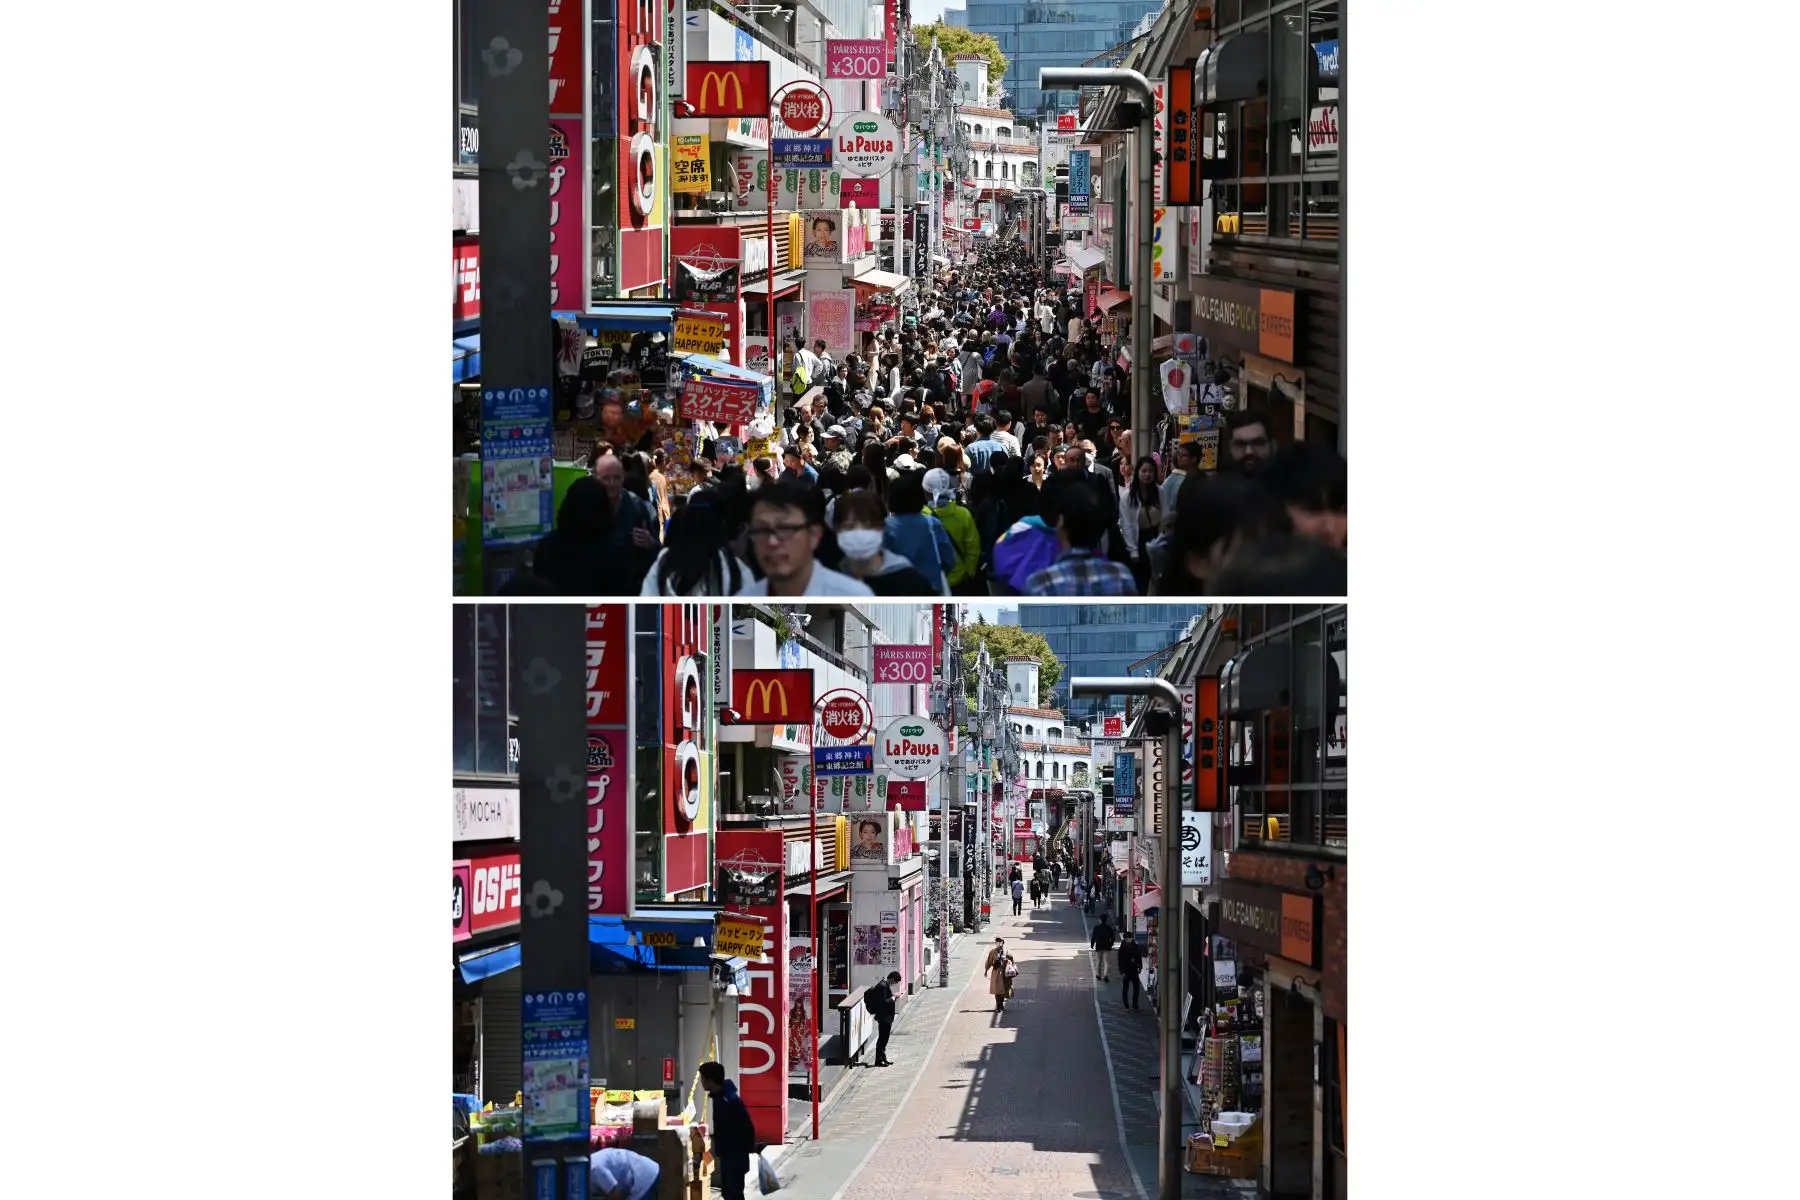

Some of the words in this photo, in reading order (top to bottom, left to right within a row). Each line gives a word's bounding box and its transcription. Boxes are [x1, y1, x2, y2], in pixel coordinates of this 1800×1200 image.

[833, 45, 858, 54] PARIS
[832, 56, 881, 76] ¥300
[783, 101, 820, 119] 消火栓
[784, 143, 821, 153] 東郷神社
[839, 135, 854, 154] La
[855, 135, 894, 155] Pausa
[675, 159, 705, 175] 空席
[1163, 270, 1174, 279] B1
[695, 280, 722, 290] TRAP
[1194, 294, 1235, 327] WOLFGANG
[1235, 302, 1257, 333] PUCK
[1261, 311, 1292, 339] EXPRESS
[677, 323, 723, 338] ハッピーワン
[675, 337, 703, 351] HAPPY
[684, 392, 756, 416] スクイーズ
[880, 650, 904, 659] PARIS
[879, 661, 927, 681] ¥300
[825, 709, 861, 726] 消火栓
[886, 739, 900, 756] La
[902, 738, 940, 757] Pausa
[826, 751, 861, 761] 東郷神社
[470, 802, 502, 823] MOCHA
[1199, 876, 1209, 884] 1F
[739, 886, 765, 894] TRAP
[1222, 898, 1260, 931] WOLFGANG
[719, 926, 763, 941] ハッピーワン
[717, 941, 743, 954] HAPPY
